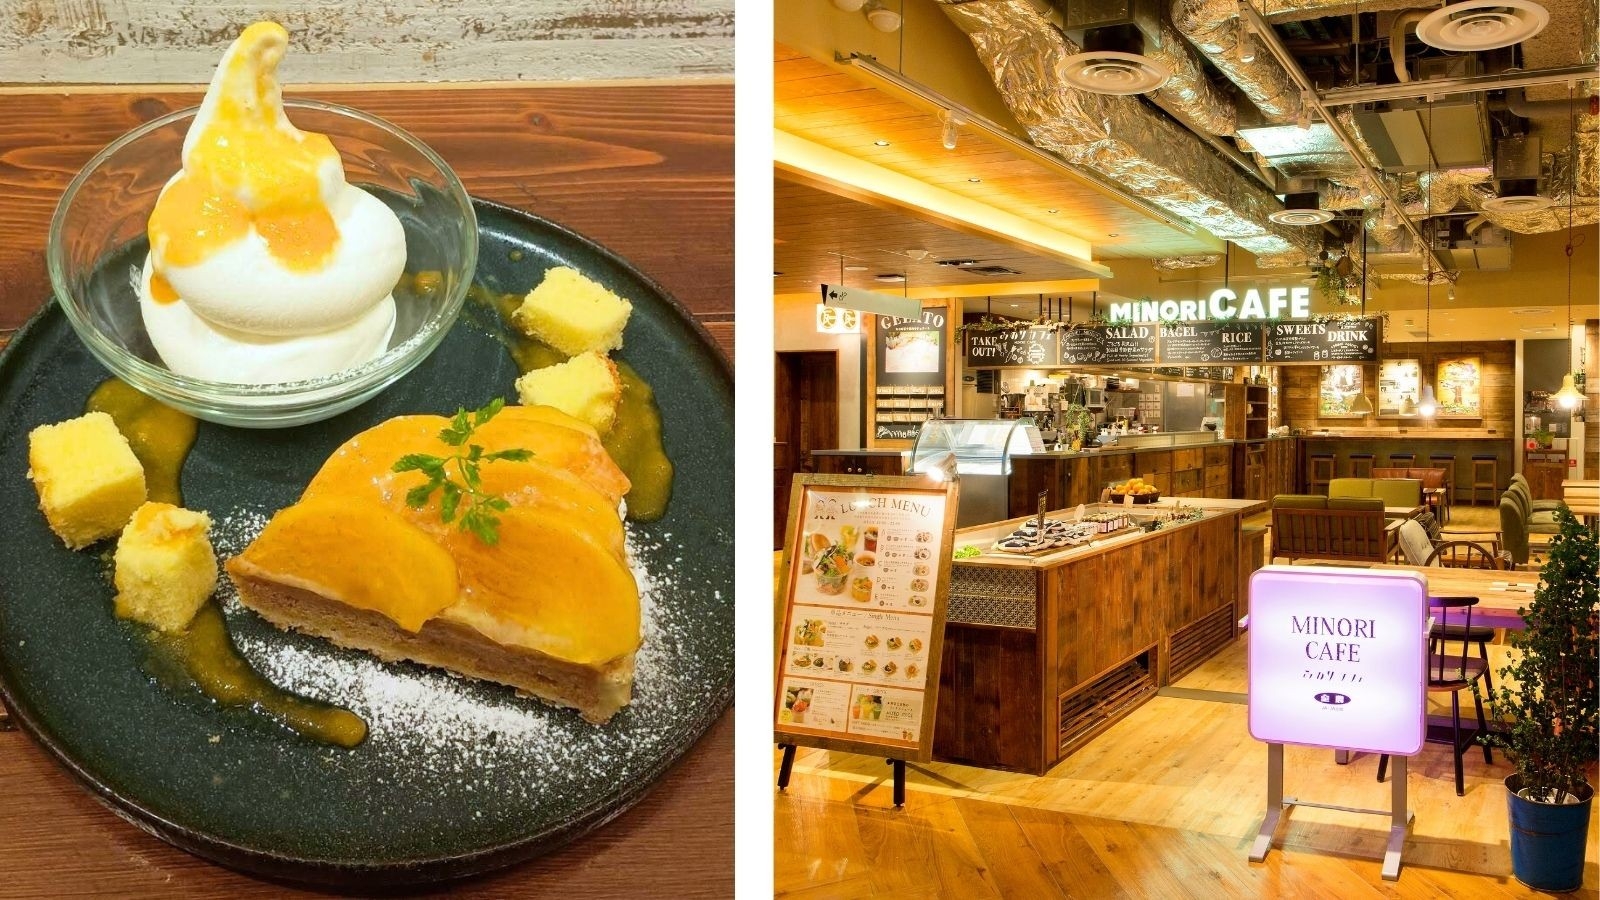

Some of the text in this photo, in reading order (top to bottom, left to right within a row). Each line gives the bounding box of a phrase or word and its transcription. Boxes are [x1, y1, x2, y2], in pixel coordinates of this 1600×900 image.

[1110, 288, 1309, 322] MINORI CAFE
[881, 311, 944, 329] GELTO
[1105, 326, 1149, 339] SALAD
[1160, 326, 1198, 337] BAGEL
[1276, 323, 1326, 336] SWEETS
[1327, 330, 1368, 342] DRINK
[971, 336, 997, 346] TAKE
[1222, 332, 1252, 343] RICE
[972, 347, 996, 357] OUT!
[840, 497, 931, 518] LUCH MENU
[1291, 615, 1376, 638] MINORI
[1305, 641, 1361, 663] CAFE
